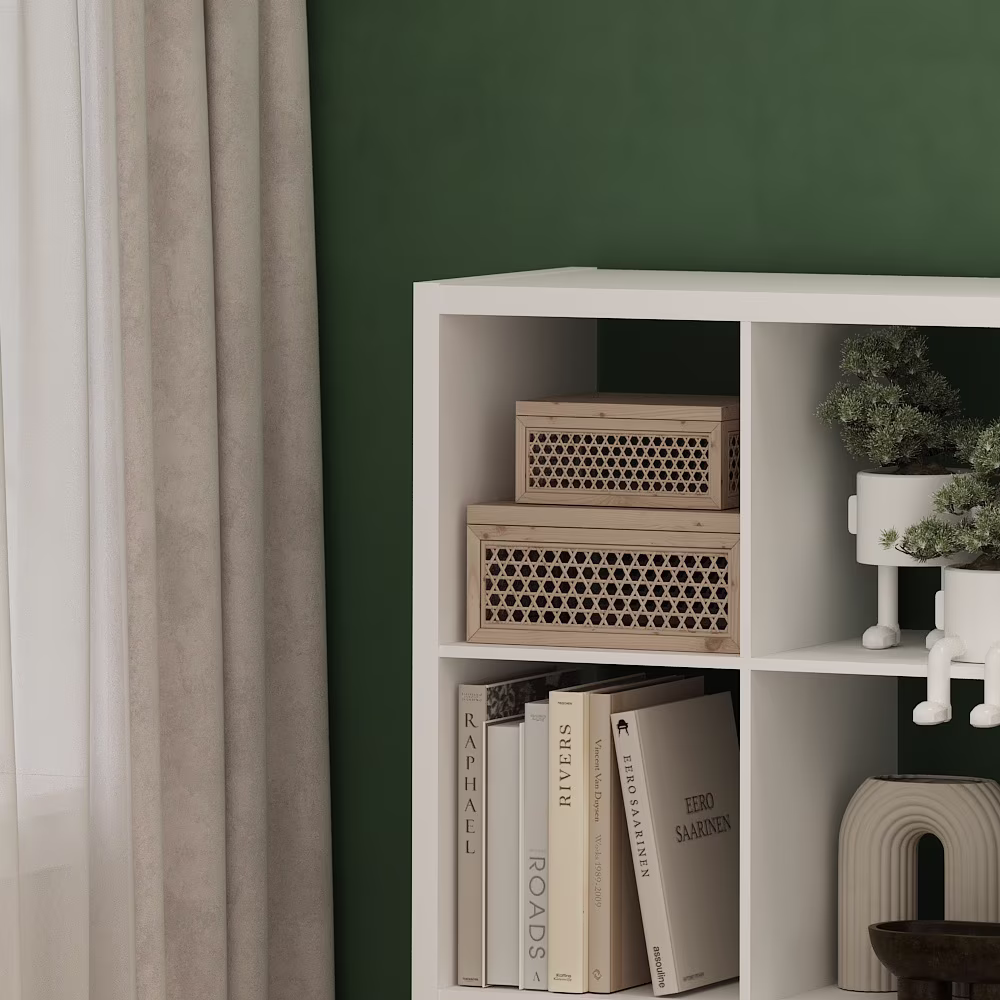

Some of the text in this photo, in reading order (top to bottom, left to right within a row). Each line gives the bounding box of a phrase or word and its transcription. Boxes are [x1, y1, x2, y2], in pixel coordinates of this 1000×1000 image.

[464, 712, 479, 854] RAPHAEL
[558, 723, 572, 808] RIVERS
[593, 739, 602, 823] Vincent Van Duysen
[684, 792, 715, 815] EERO
[623, 754, 650, 878] EERO SAARINEN
[675, 814, 732, 843] SAARINEN
[528, 856, 546, 960] ROADS
[653, 946, 666, 989] assouline
